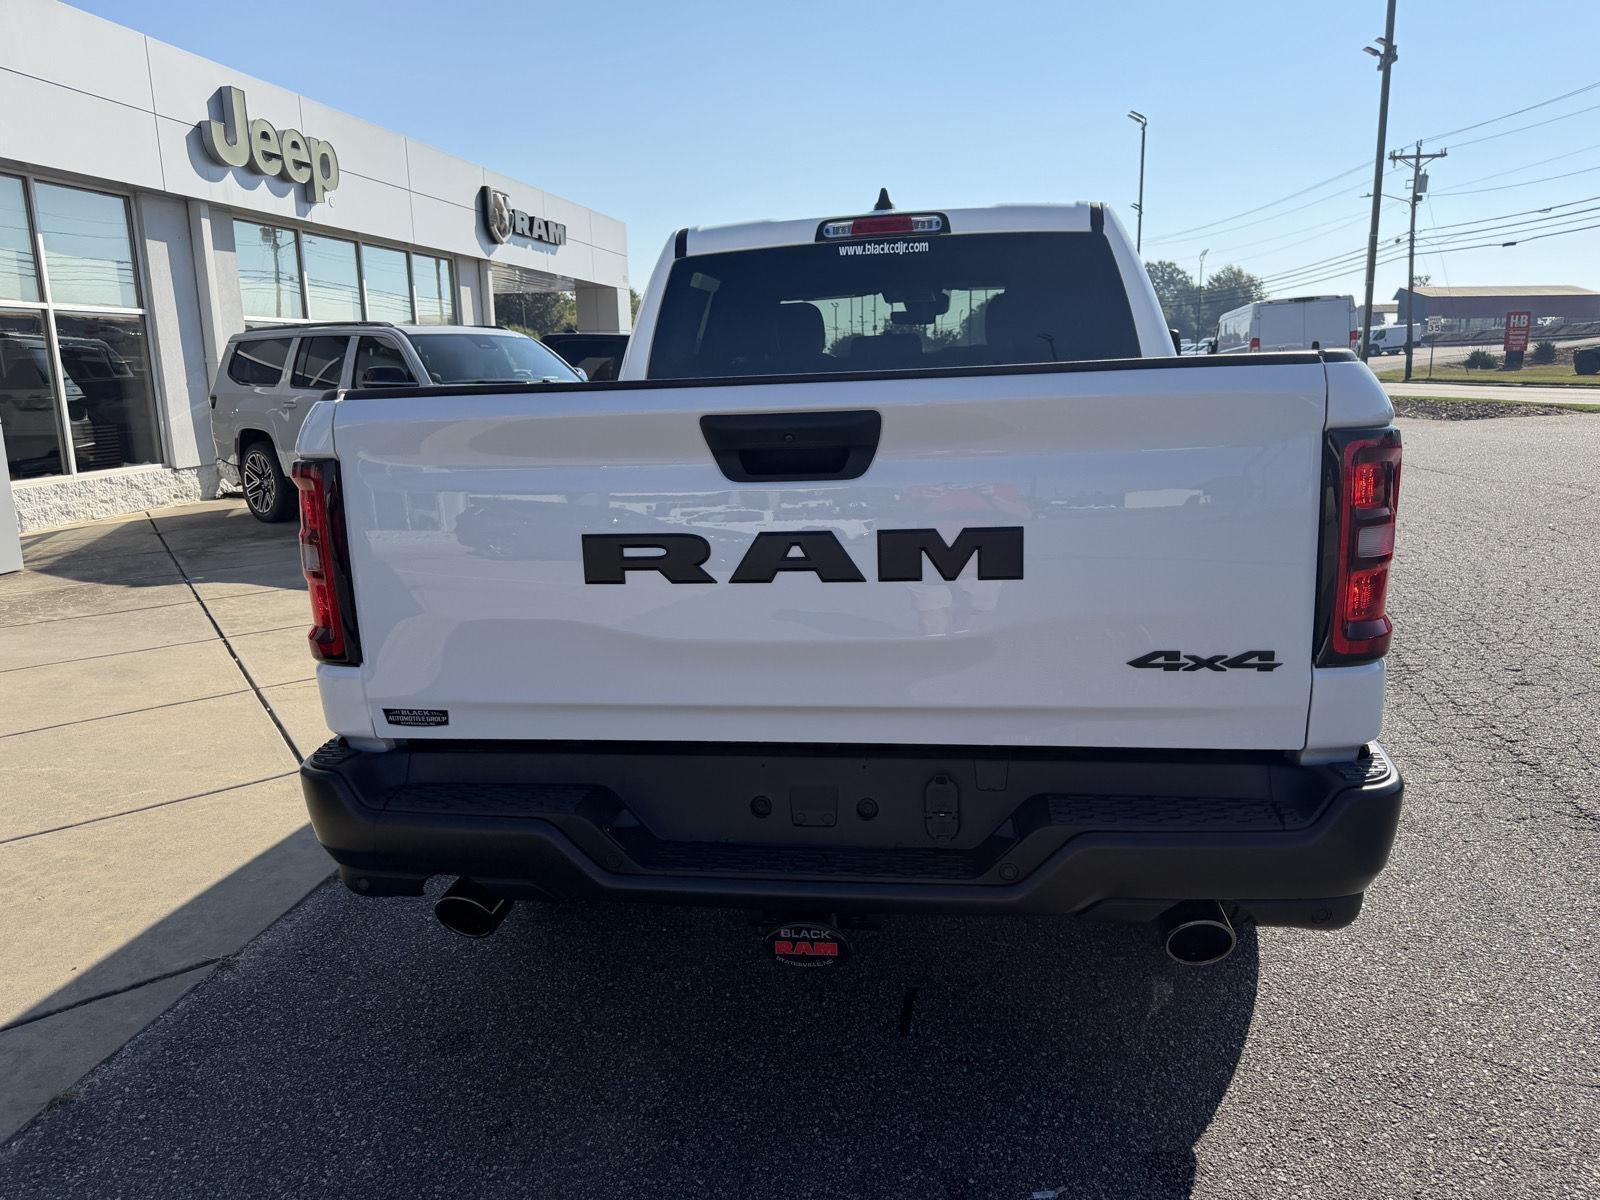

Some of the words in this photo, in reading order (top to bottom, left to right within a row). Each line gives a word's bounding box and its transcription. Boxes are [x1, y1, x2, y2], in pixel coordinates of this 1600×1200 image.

[200, 85, 339, 203] Jeep
[512, 208, 566, 245] RAM
[839, 242, 929, 256] www.blackcdjr.com
[582, 526, 1024, 585] RAM
[1127, 650, 1283, 672] 4x4
[780, 929, 831, 939] BLACK
[775, 940, 838, 956] RAM
